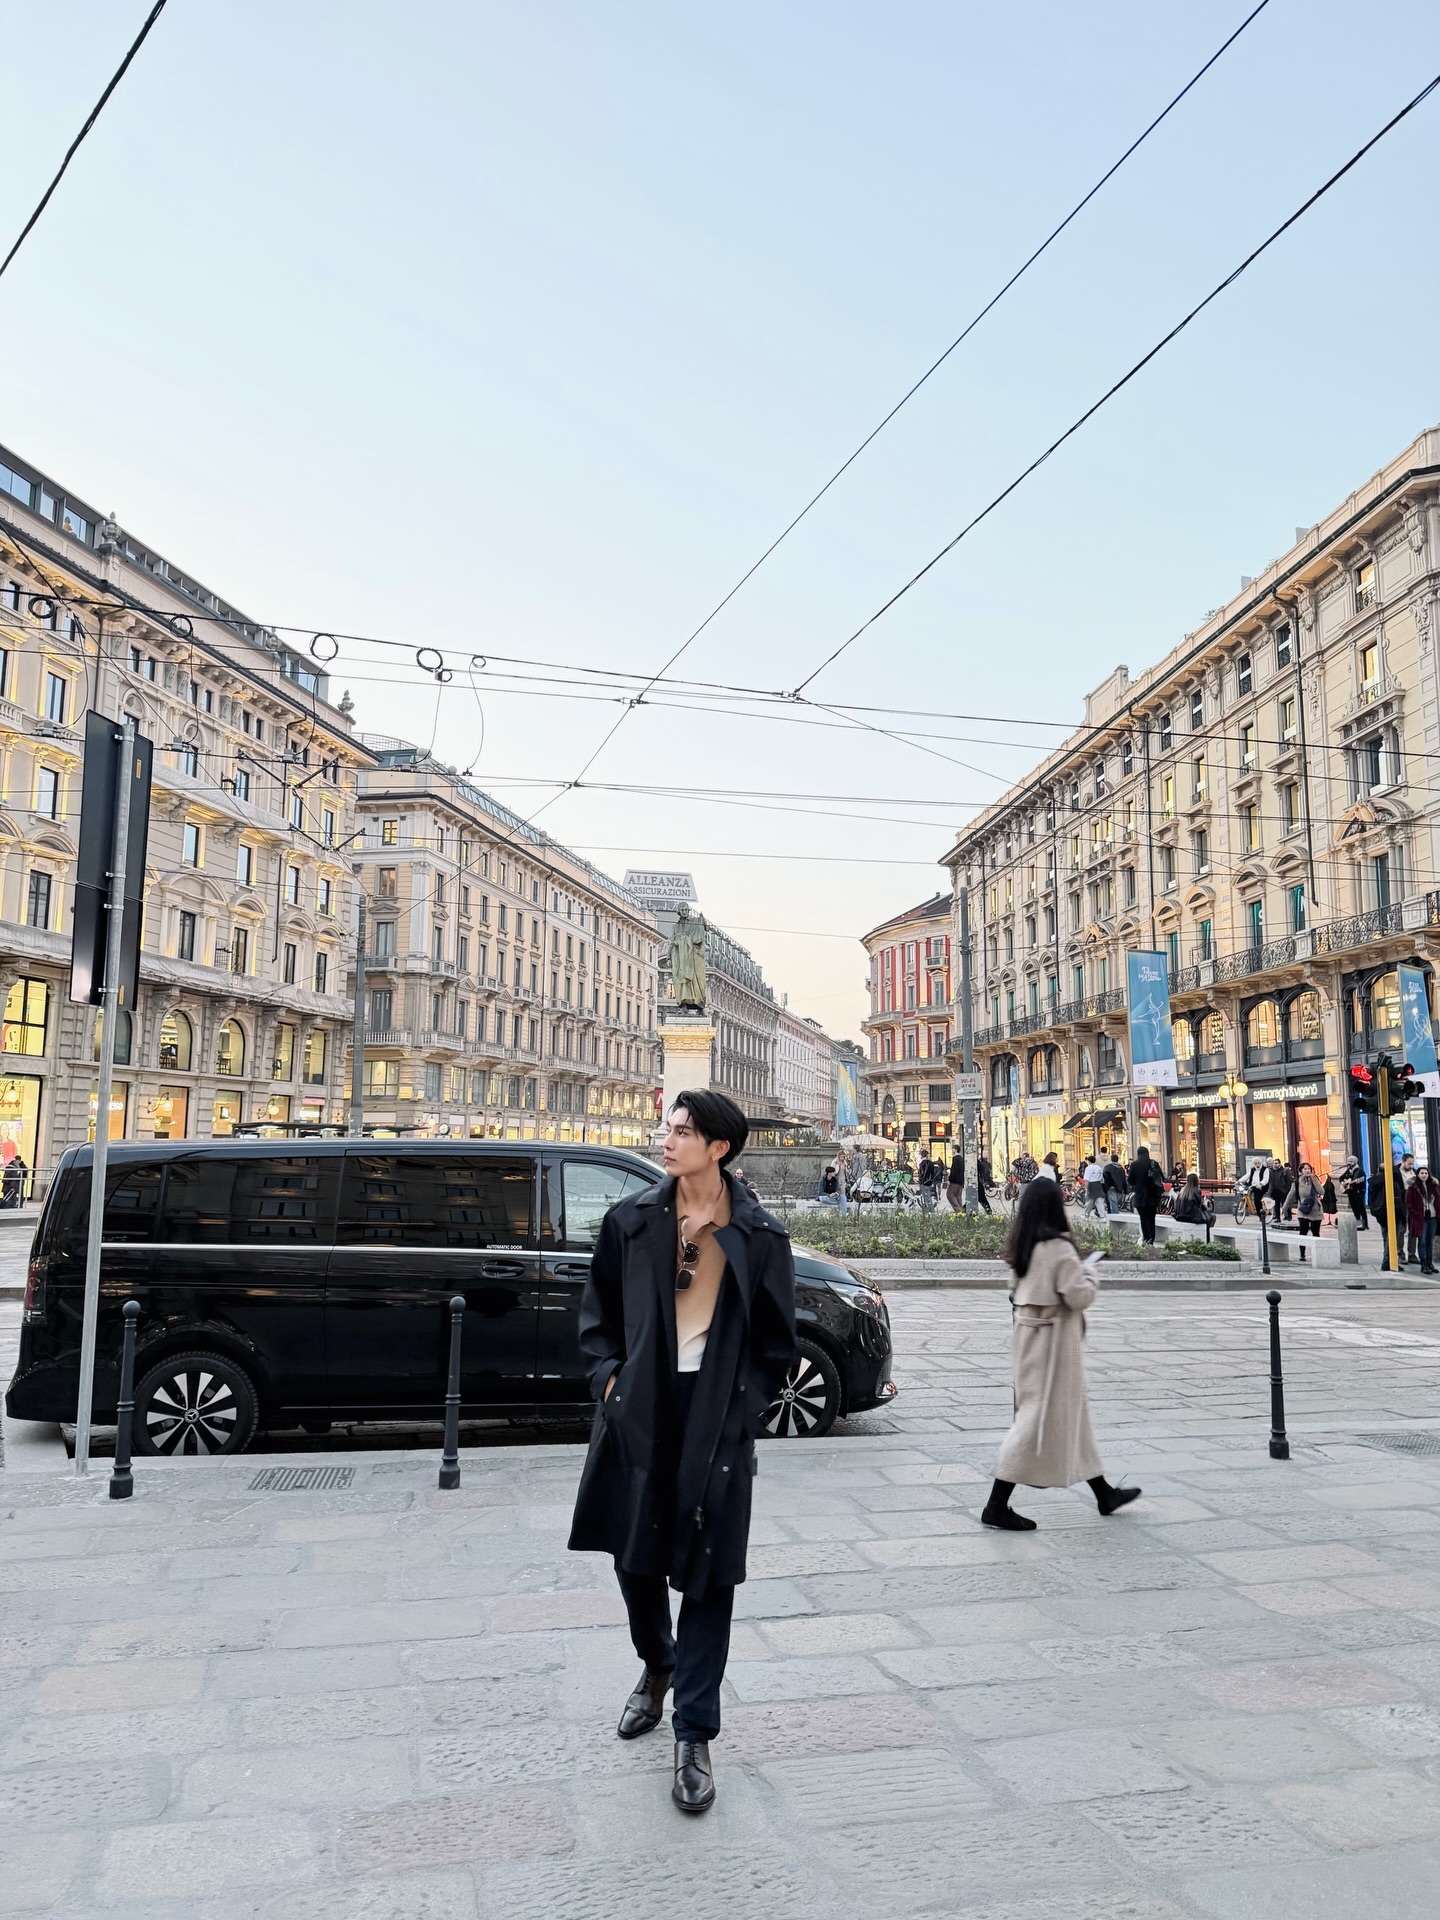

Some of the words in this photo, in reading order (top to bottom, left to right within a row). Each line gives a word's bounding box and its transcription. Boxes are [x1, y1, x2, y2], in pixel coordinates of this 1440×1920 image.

[628, 875, 690, 888] ALLEANZA
[629, 886, 691, 897] ASSICURAZIONI
[1142, 1102, 1158, 1114] M
